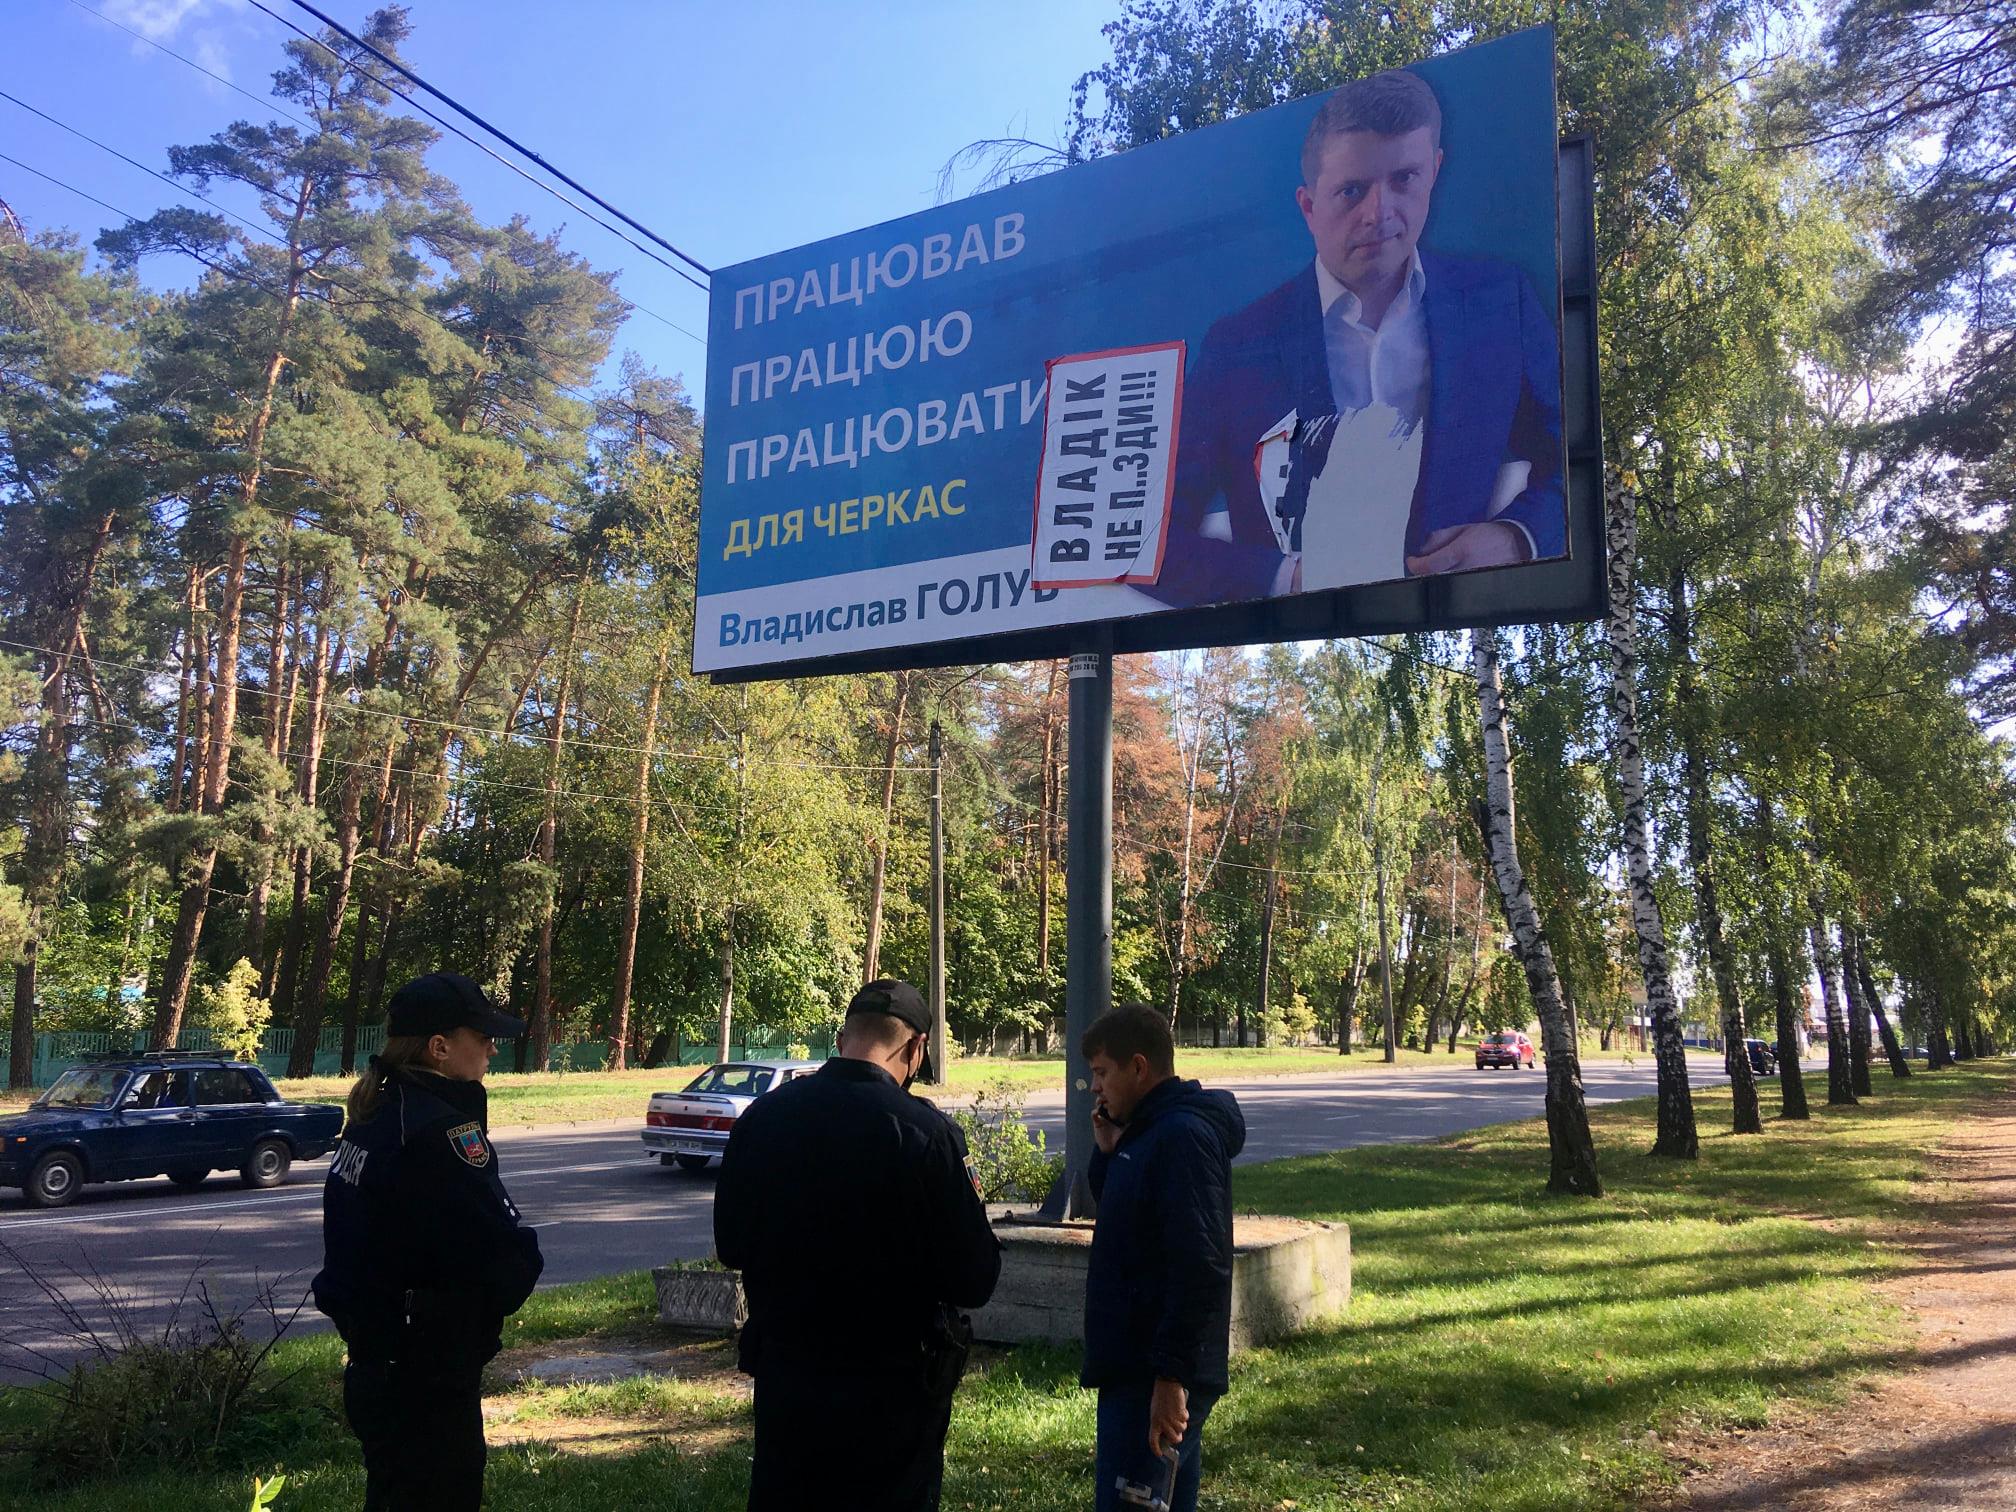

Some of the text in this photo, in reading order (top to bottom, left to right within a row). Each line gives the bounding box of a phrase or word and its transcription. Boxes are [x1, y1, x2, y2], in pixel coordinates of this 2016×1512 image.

[735, 213, 1025, 330] ПРАЦЮВАВ
[731, 310, 972, 407] ПРАЦЮЮ
[1050, 372, 1106, 562] ВЛАДІК
[1104, 370, 1158, 561] НЕ П..ЗДИ!!!
[723, 479, 966, 560] ДЛЯ ЧЕРКАС
[719, 598, 906, 647] Владислав
